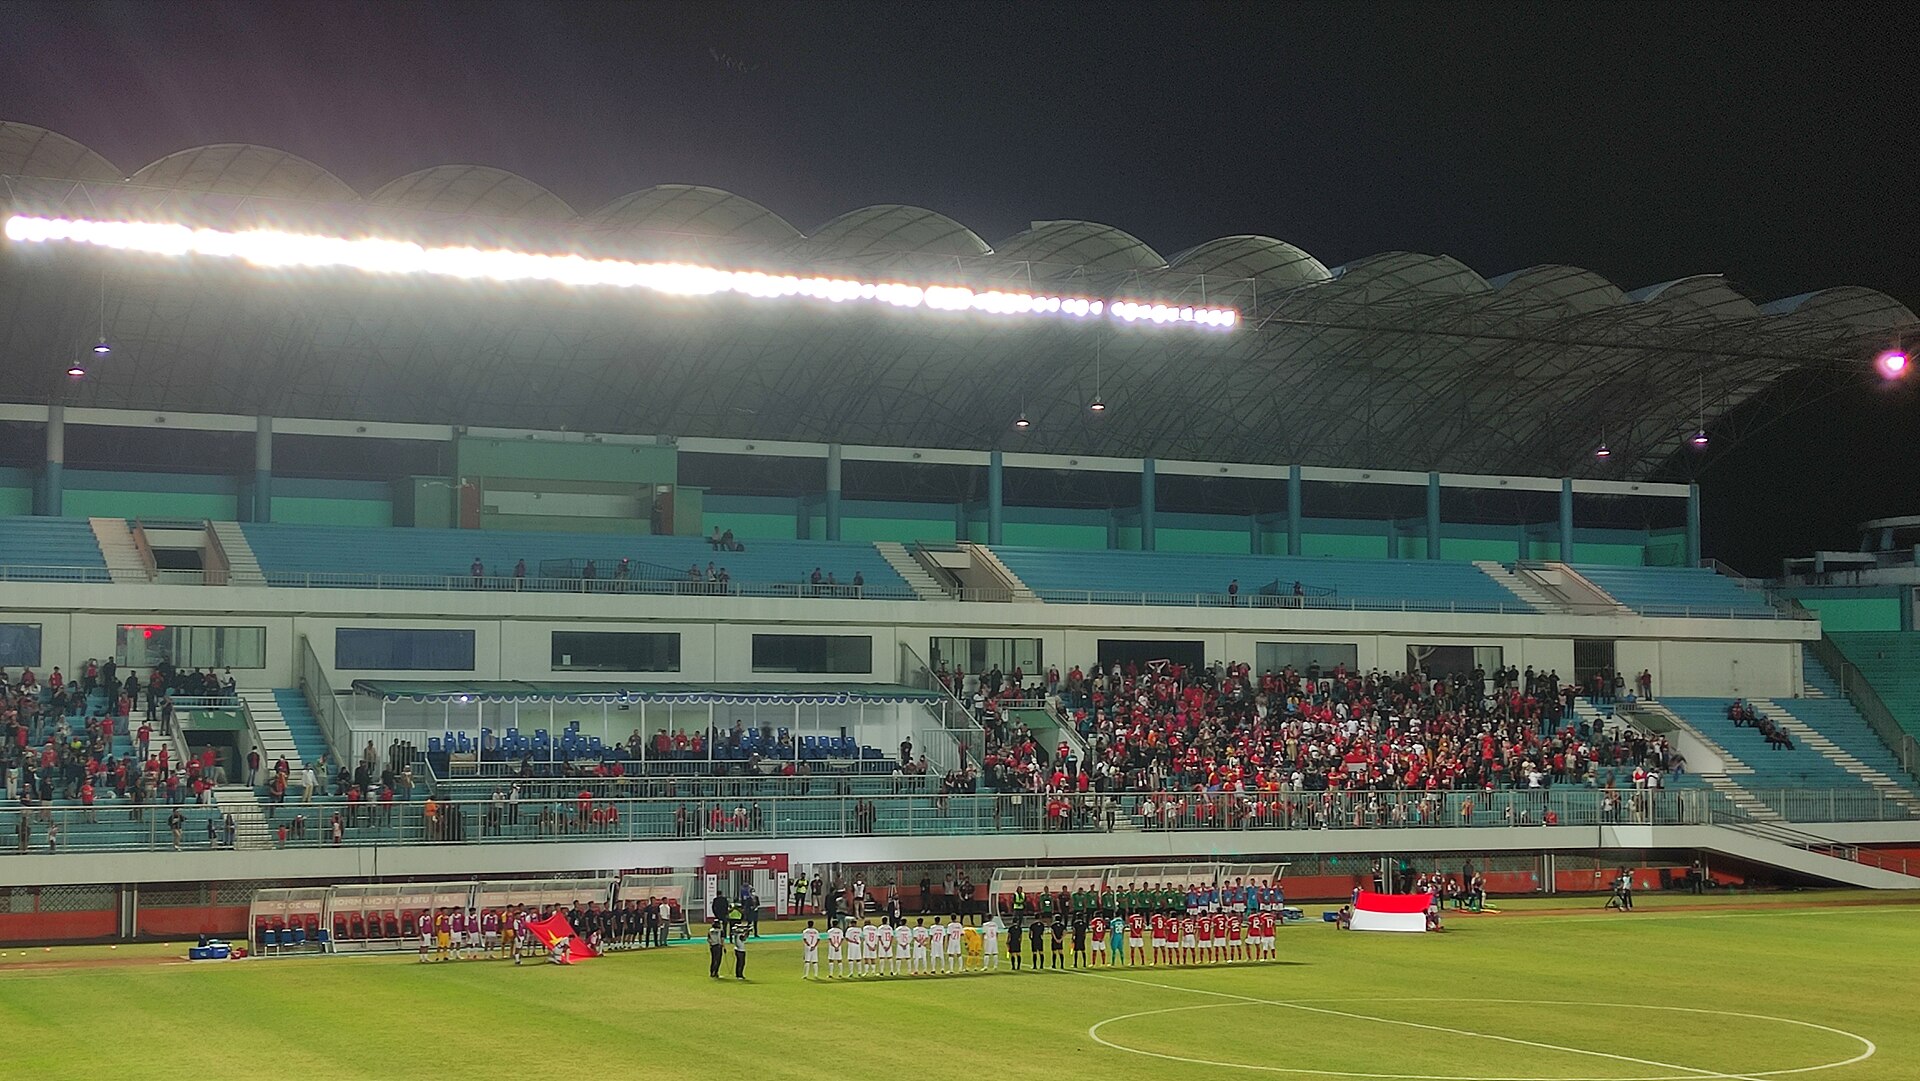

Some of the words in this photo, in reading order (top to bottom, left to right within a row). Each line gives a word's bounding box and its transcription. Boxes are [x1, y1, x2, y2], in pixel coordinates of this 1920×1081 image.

[1203, 923, 1209, 932] 9
[1218, 920, 1224, 930] 2
[1252, 919, 1260, 929] 12
